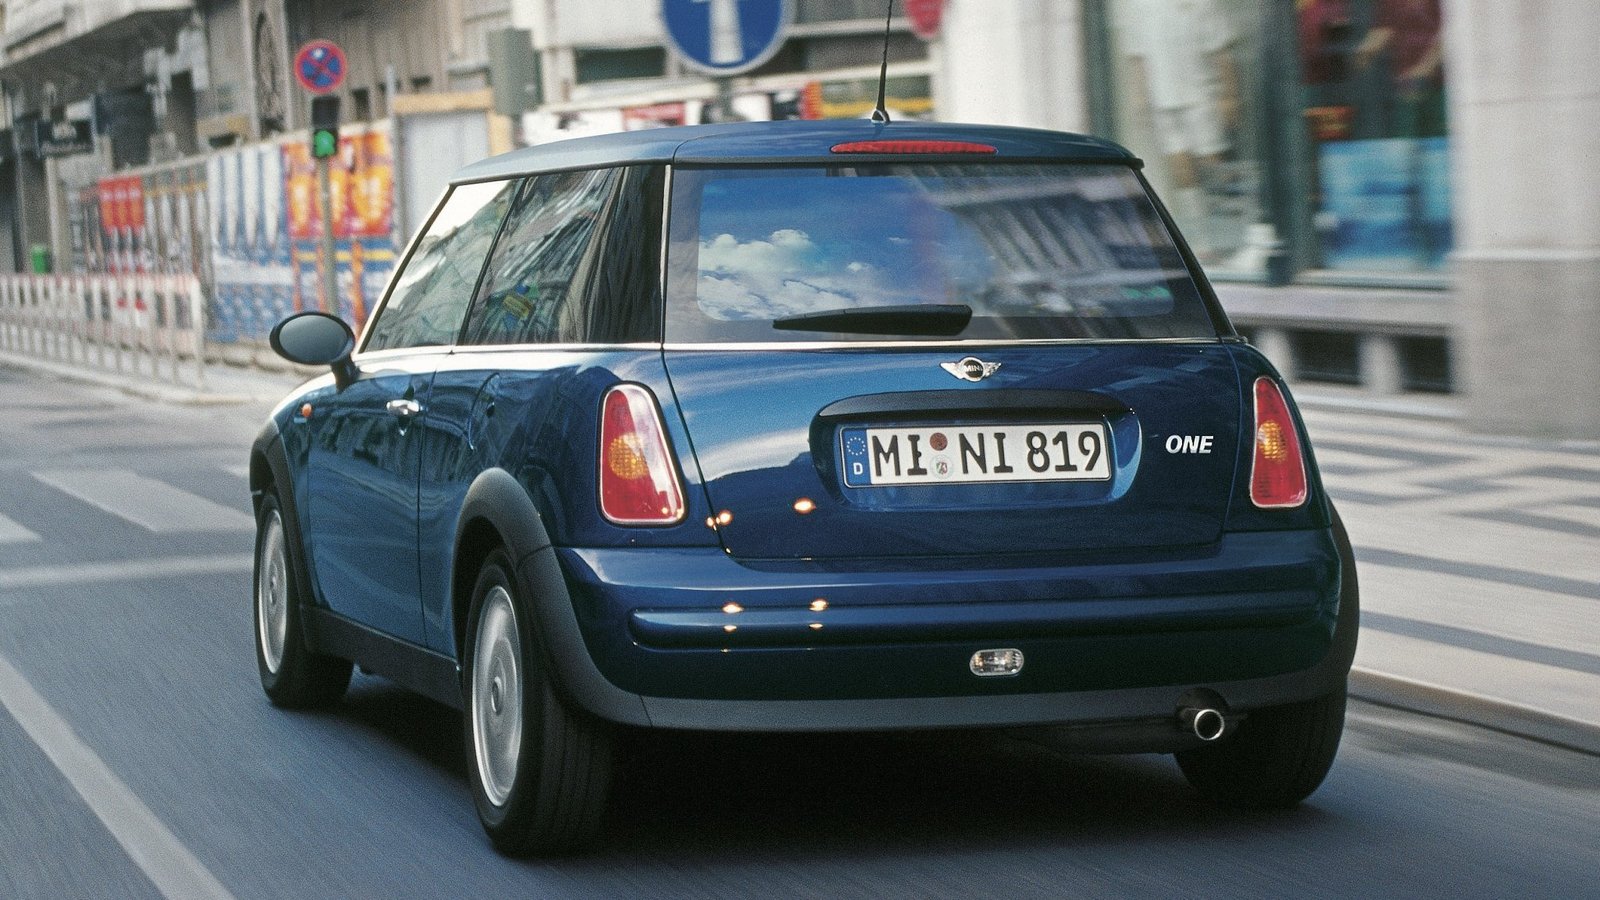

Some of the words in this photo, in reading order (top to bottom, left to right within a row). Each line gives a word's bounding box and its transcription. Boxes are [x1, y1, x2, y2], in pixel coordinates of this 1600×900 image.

[872, 434, 928, 477] MI
[958, 432, 1013, 474] NI
[1026, 430, 1101, 473] 819
[1165, 434, 1214, 454] ONE
[853, 462, 863, 475] D
